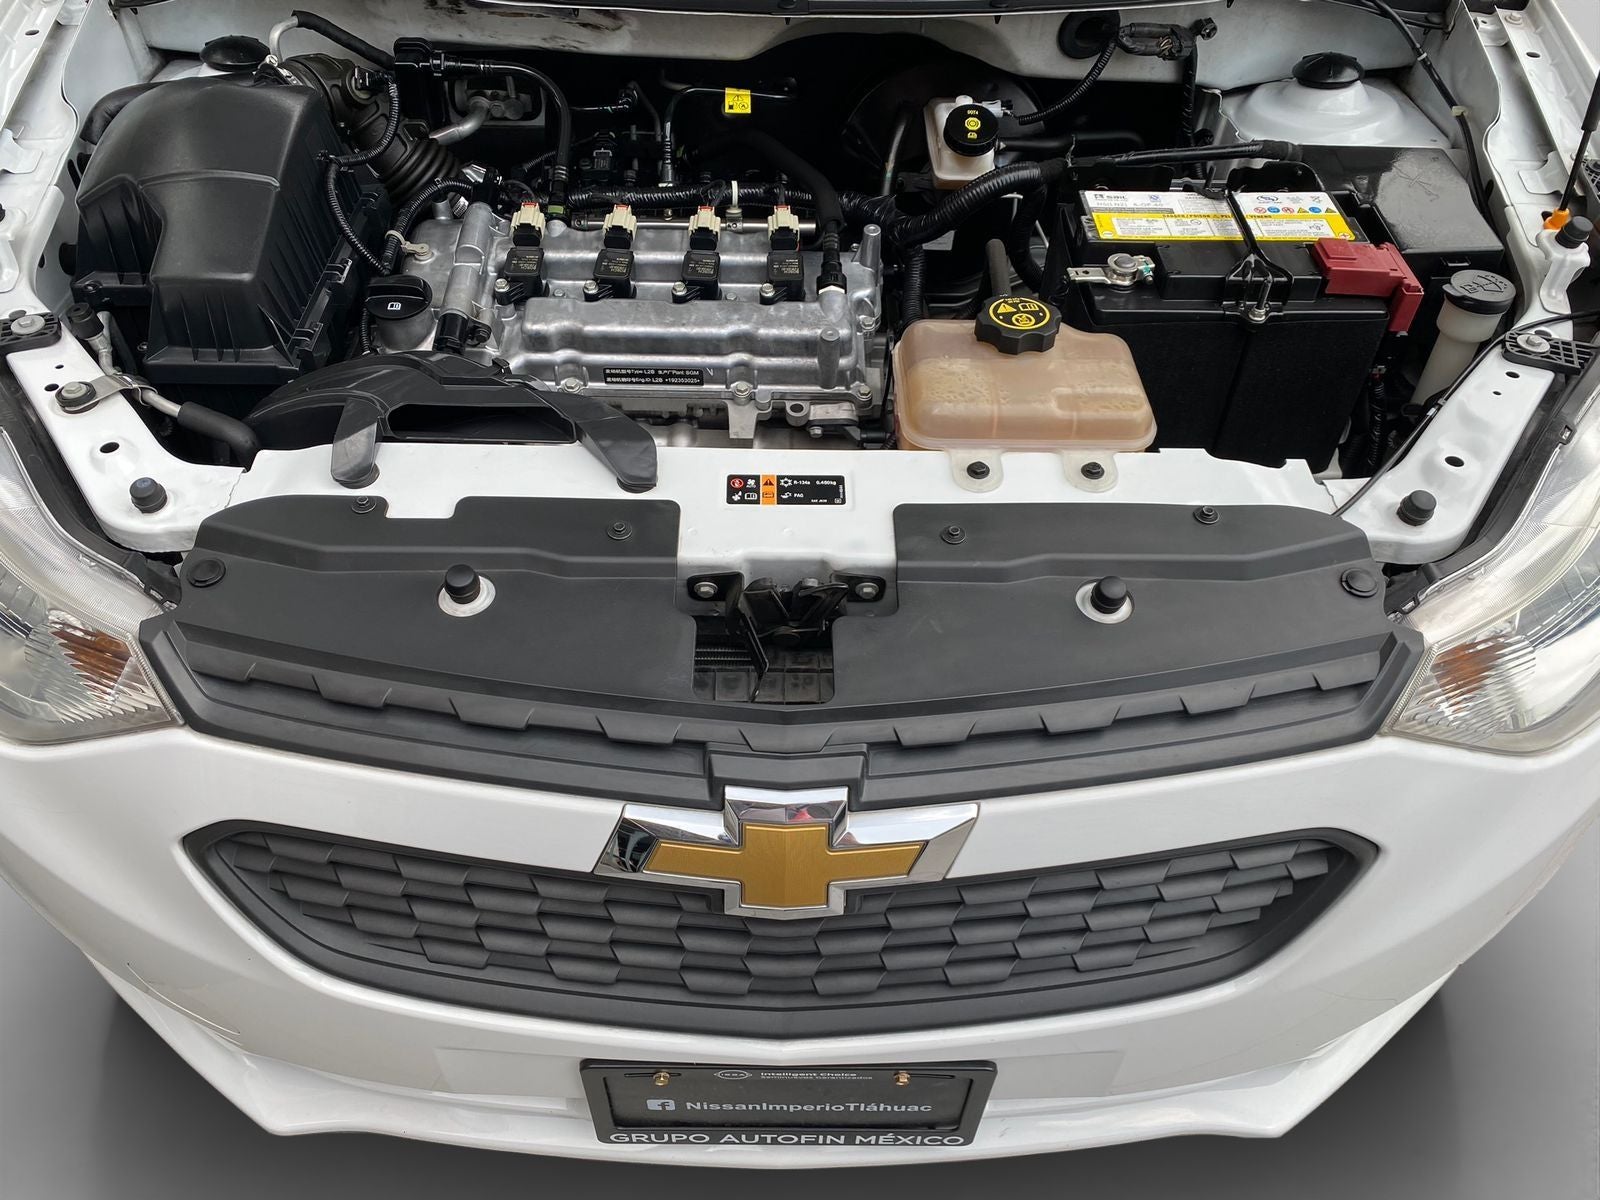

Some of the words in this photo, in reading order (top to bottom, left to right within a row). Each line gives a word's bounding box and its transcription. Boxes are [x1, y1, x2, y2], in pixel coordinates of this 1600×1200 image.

[685, 1102, 933, 1113] NissanImperioTláhuac
[609, 1133, 710, 1144] GRUPO
[719, 1134, 846, 1145] AUTOFIN
[855, 1132, 965, 1146] MÉXICO
